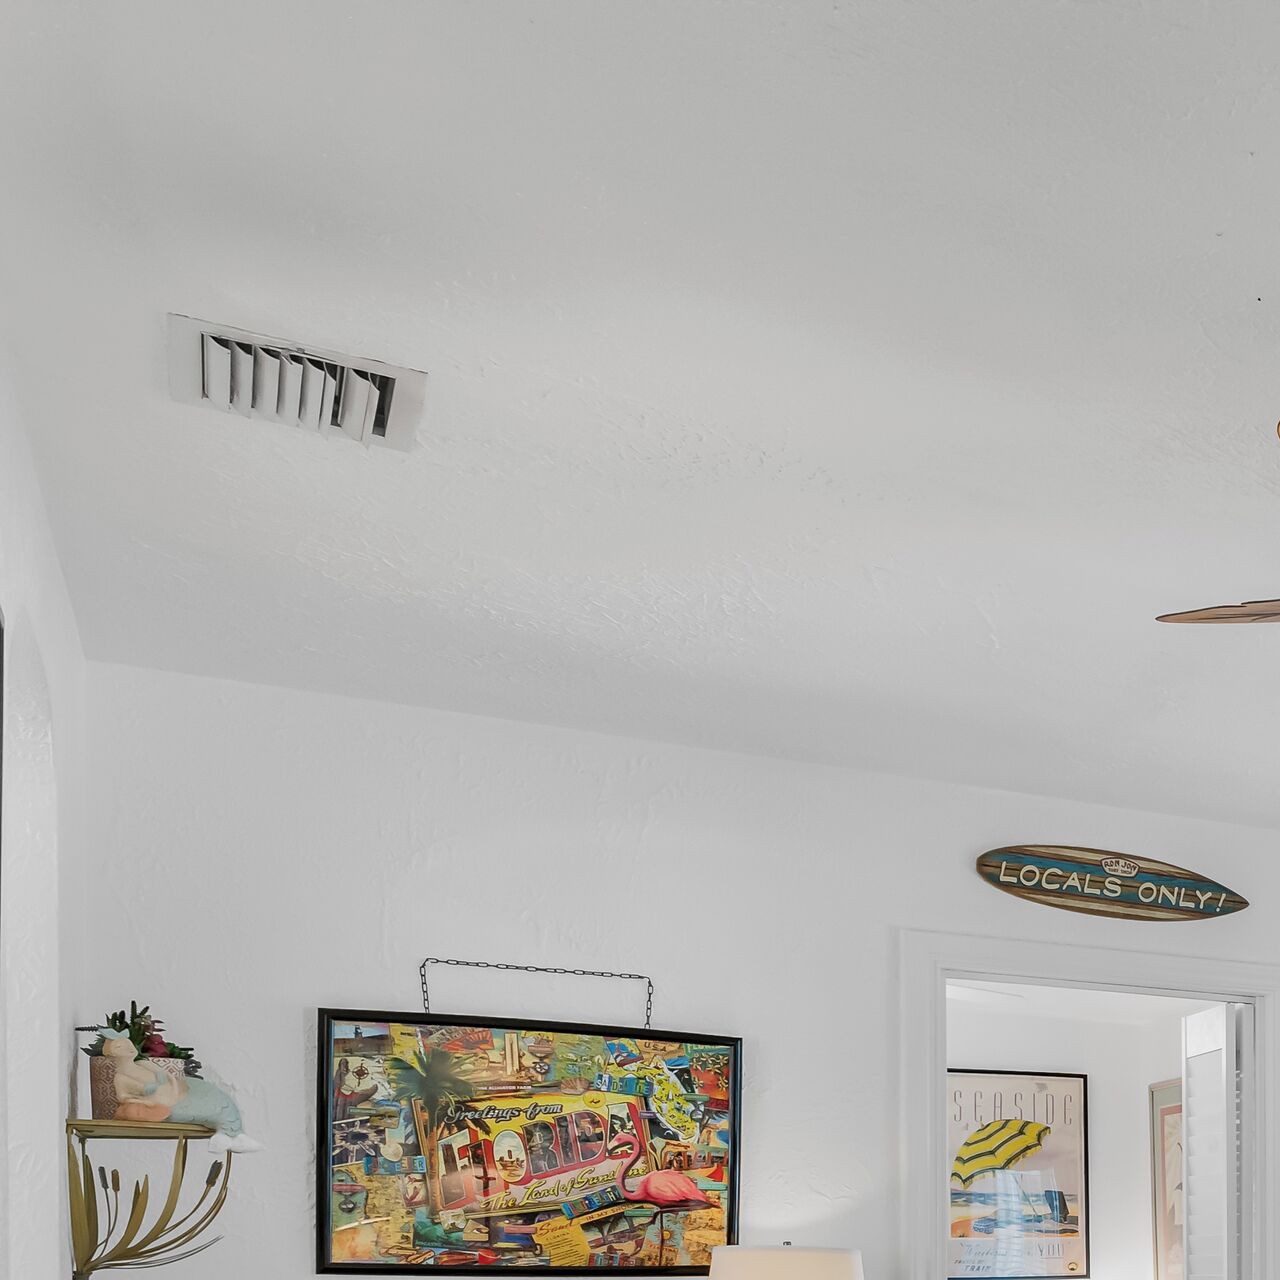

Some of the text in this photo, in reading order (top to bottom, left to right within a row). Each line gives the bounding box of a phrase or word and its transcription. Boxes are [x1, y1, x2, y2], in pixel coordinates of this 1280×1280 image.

[1000, 861, 1226, 912] LOCALS ONLY!
[445, 1102, 562, 1124] Greetings from
[953, 1090, 1073, 1126] SEASIDE
[437, 1102, 646, 1207] FLORIDA
[480, 1192, 516, 1210] The
[519, 1179, 560, 1206] Land
[560, 1178, 576, 1197] of
[574, 1161, 649, 1190] Sunsne
